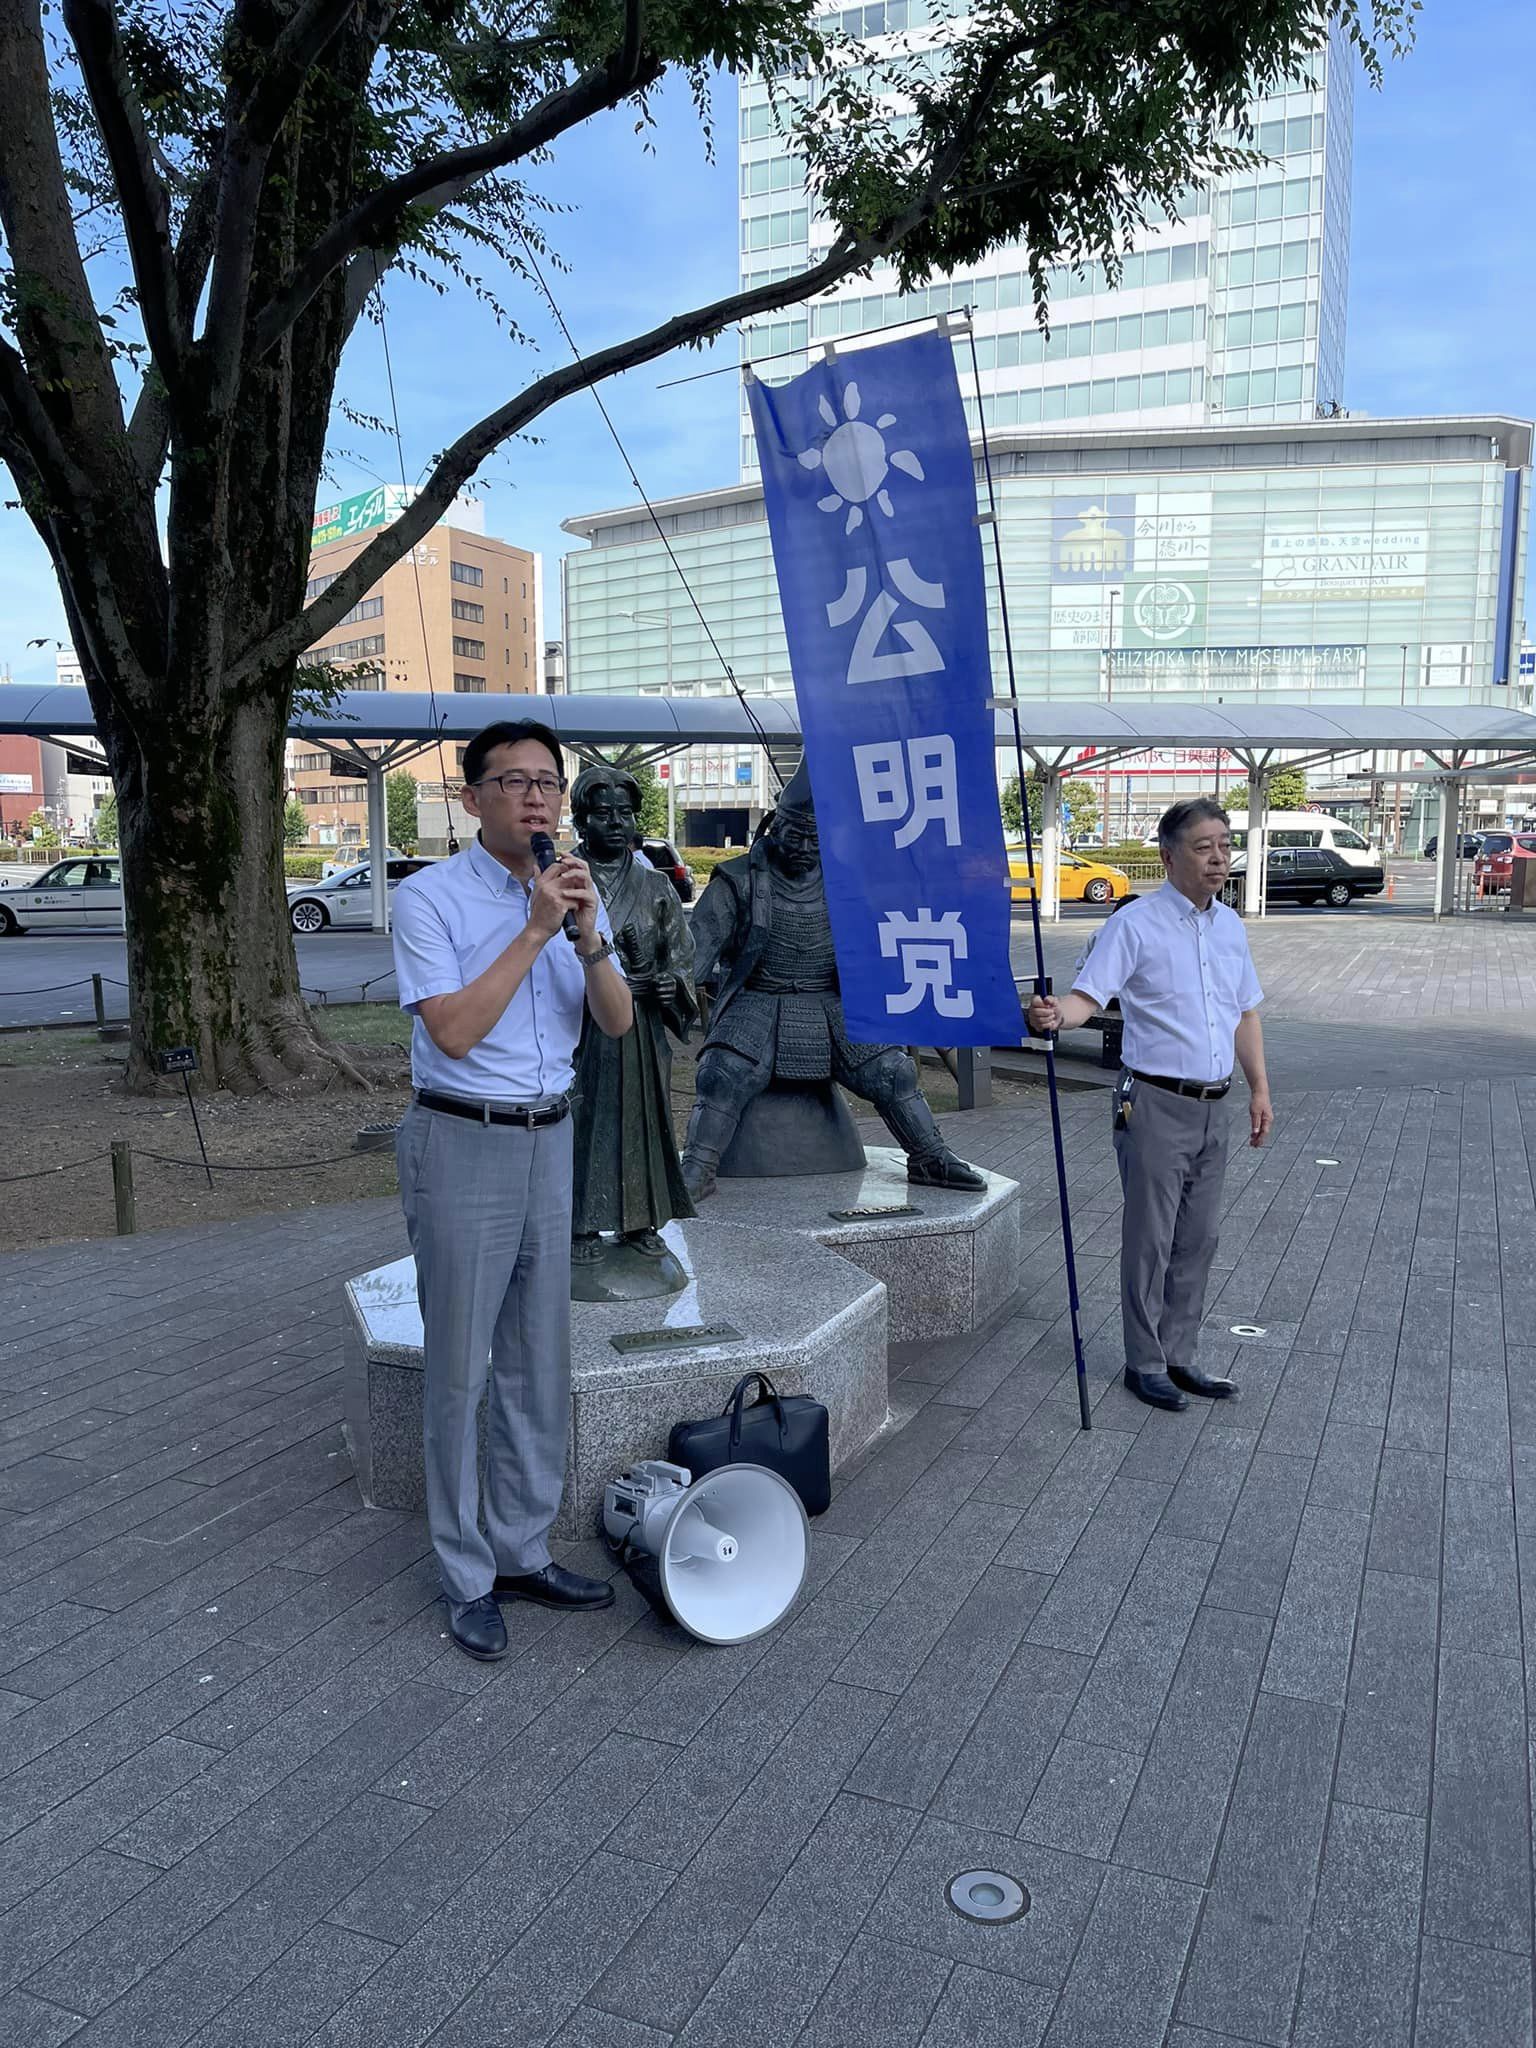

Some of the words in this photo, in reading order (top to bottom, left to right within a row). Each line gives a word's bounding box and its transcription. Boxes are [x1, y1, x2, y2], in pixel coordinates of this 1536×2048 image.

[344, 487, 384, 536] エイブル
[1136, 518, 1197, 536] 今川から
[1303, 555, 1408, 572] GRANDAIR
[1107, 650, 1186, 667] SHIZUOKA
[1192, 649, 1227, 666] CITY
[1236, 647, 1306, 665] MUSEUM
[1332, 646, 1364, 663] ART
[825, 557, 975, 1019] 公明党
